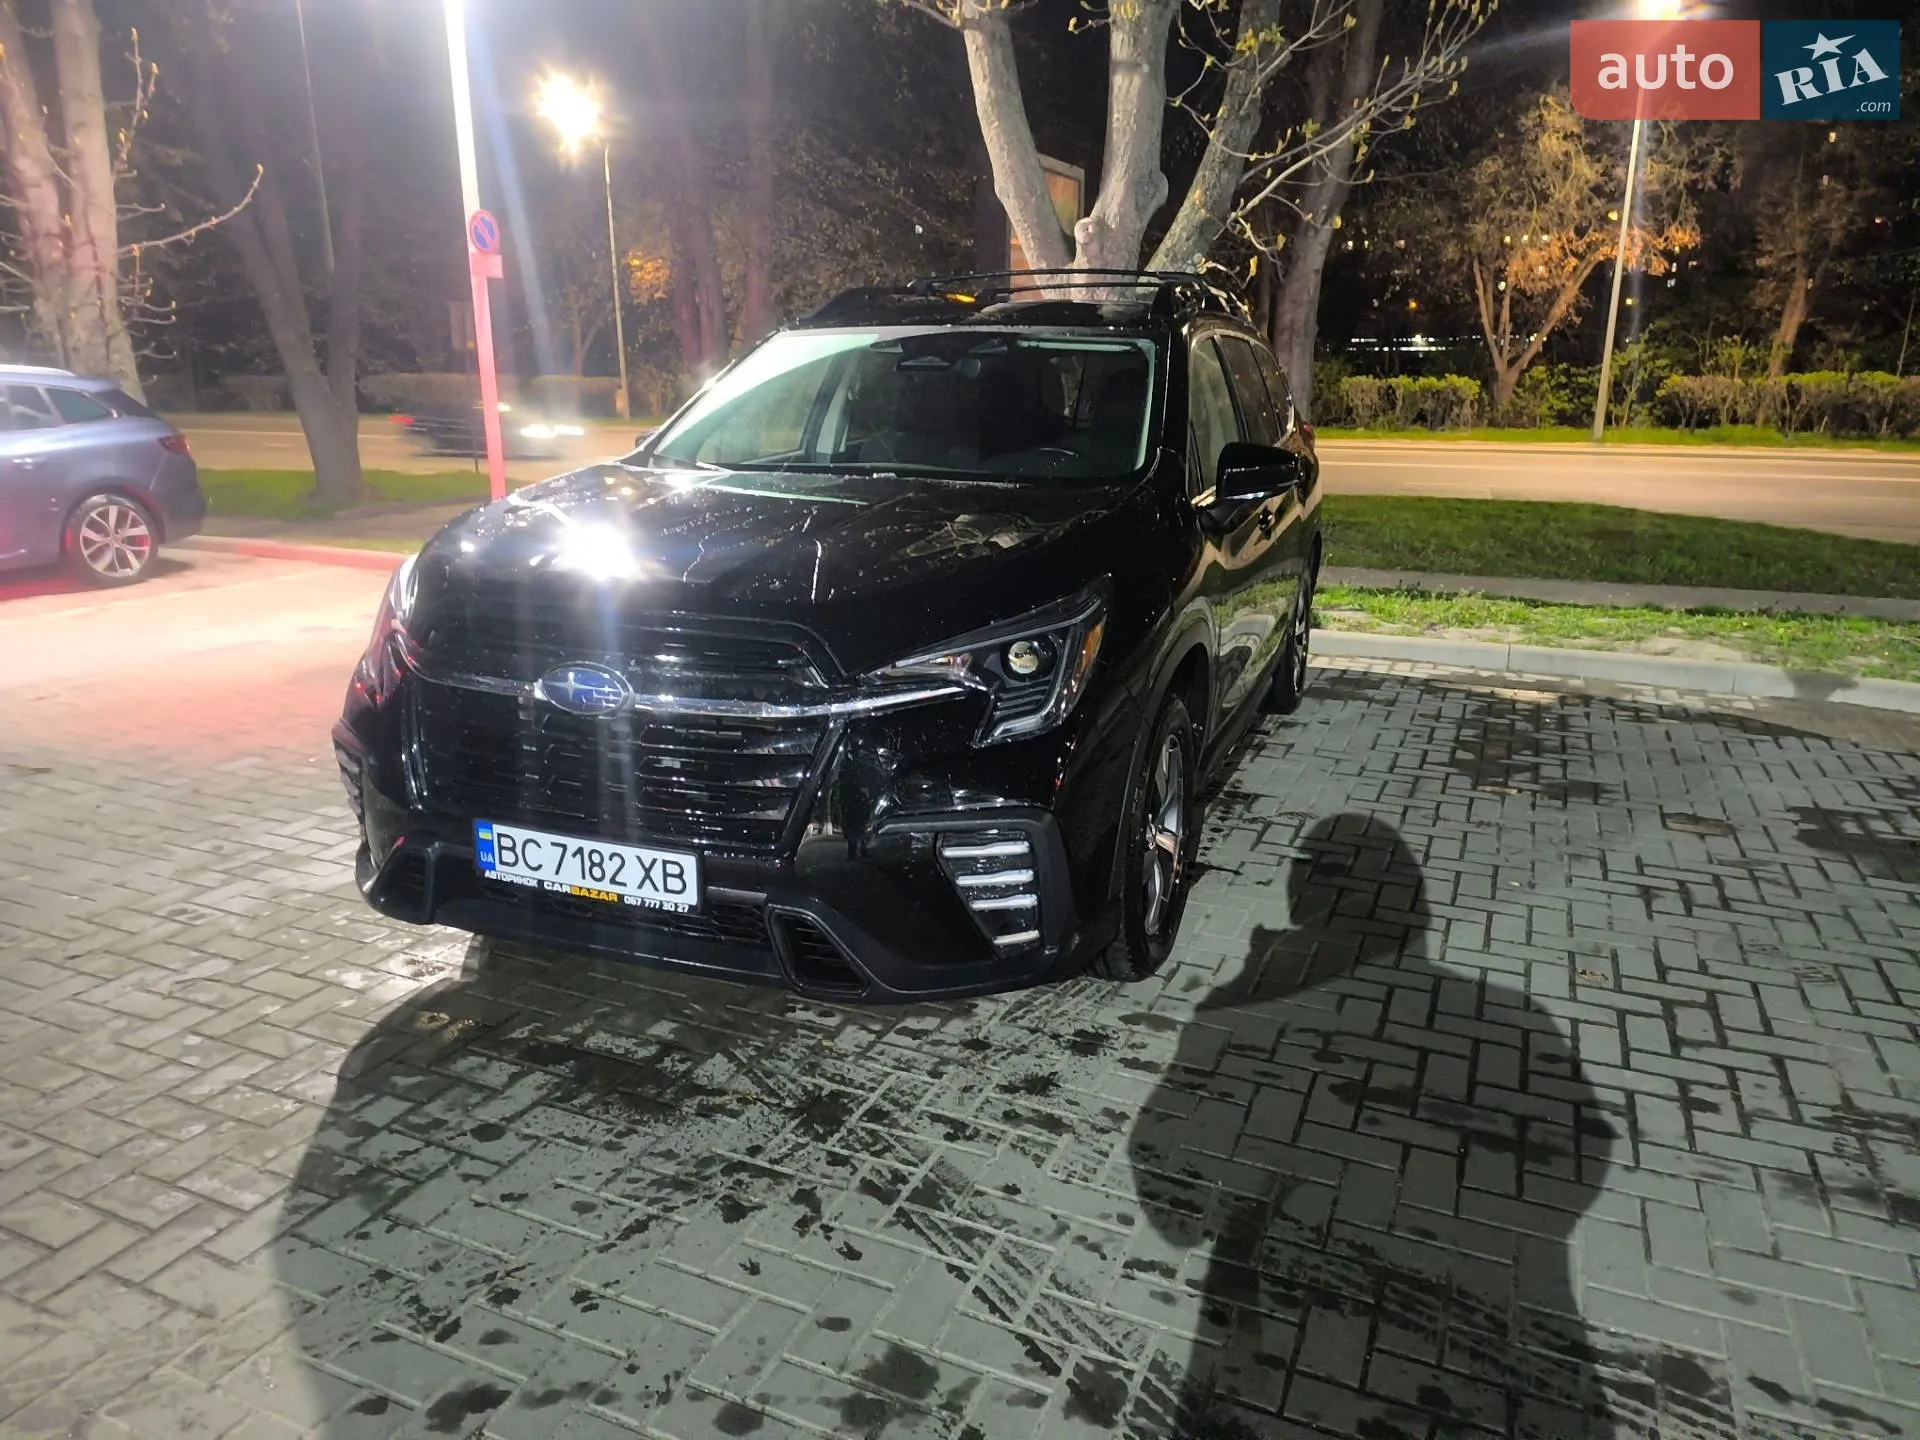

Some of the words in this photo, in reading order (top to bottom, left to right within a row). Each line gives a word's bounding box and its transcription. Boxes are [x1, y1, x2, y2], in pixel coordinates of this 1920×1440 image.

[480, 851, 495, 864] UA
[497, 832, 543, 872] BC
[550, 841, 627, 887] 7182
[636, 855, 687, 895] XB
